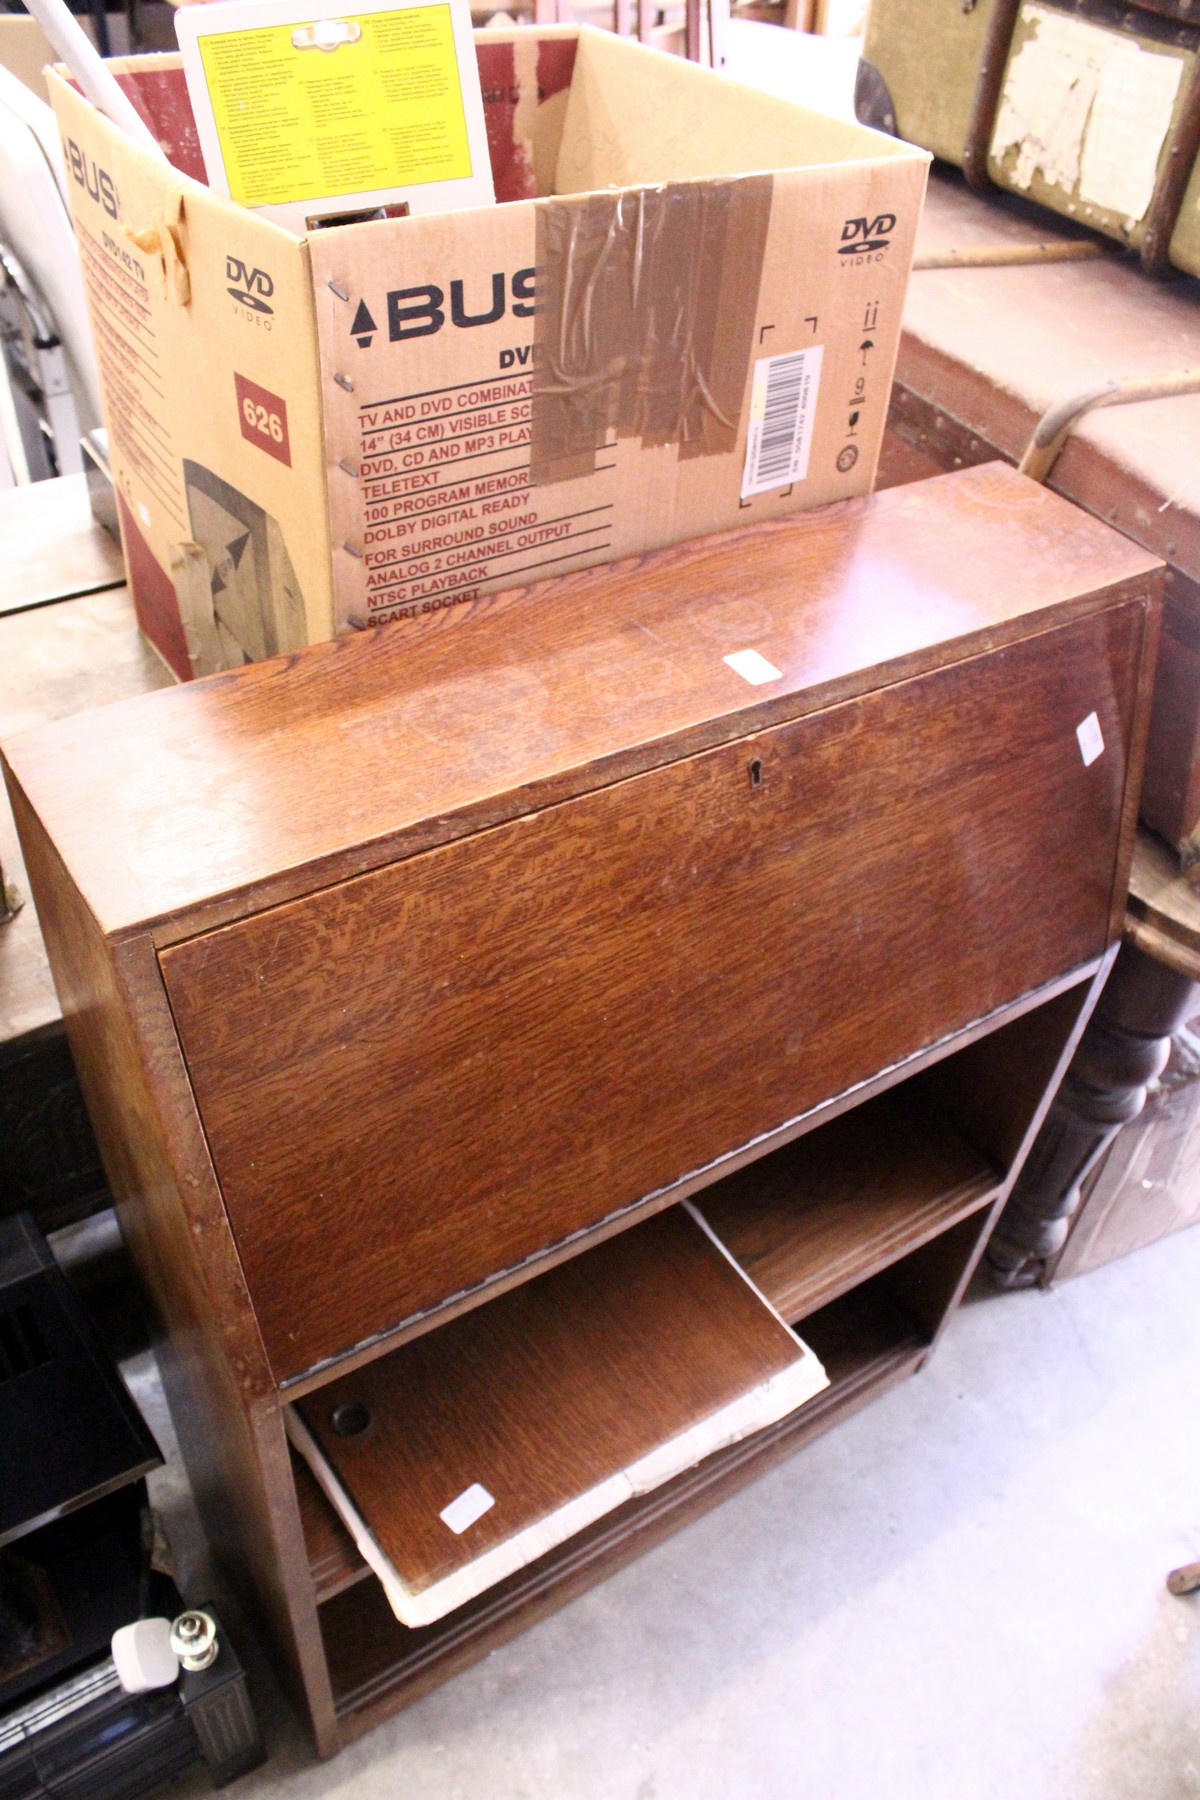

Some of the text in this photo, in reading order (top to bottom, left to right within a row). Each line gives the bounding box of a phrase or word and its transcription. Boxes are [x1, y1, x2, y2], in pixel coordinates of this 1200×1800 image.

[66, 137, 121, 221] BUS
[840, 213, 896, 241] DVD
[226, 255, 274, 297] DVD
[840, 252, 884, 268] VIDEO
[232, 304, 272, 331] VIDEO
[499, 345, 536, 369] DV
[242, 398, 284, 443] 626
[358, 414, 377, 429] TV
[383, 406, 415, 424] AND
[420, 397, 452, 416] DVD
[389, 428, 411, 449] (34
[416, 421, 445, 442] CM)
[448, 407, 506, 432] VISIBLE
[360, 459, 397, 477] DVD,
[402, 451, 424, 467] CD
[429, 441, 460, 461] AND
[465, 432, 495, 453] MP3
[361, 471, 440, 499] TELETEXT
[363, 507, 388, 521] 100
[393, 487, 470, 516] PROGRAM
[363, 493, 530, 544] DOLBY DIGITAL READY
[364, 512, 538, 565] FOR SURROUND SOUND
[365, 523, 572, 587] ANALOG 2 CHANNEL OUTPUT
[366, 566, 488, 608] NTSC PLAYBACK
[367, 588, 481, 628] SCART SOCKET
